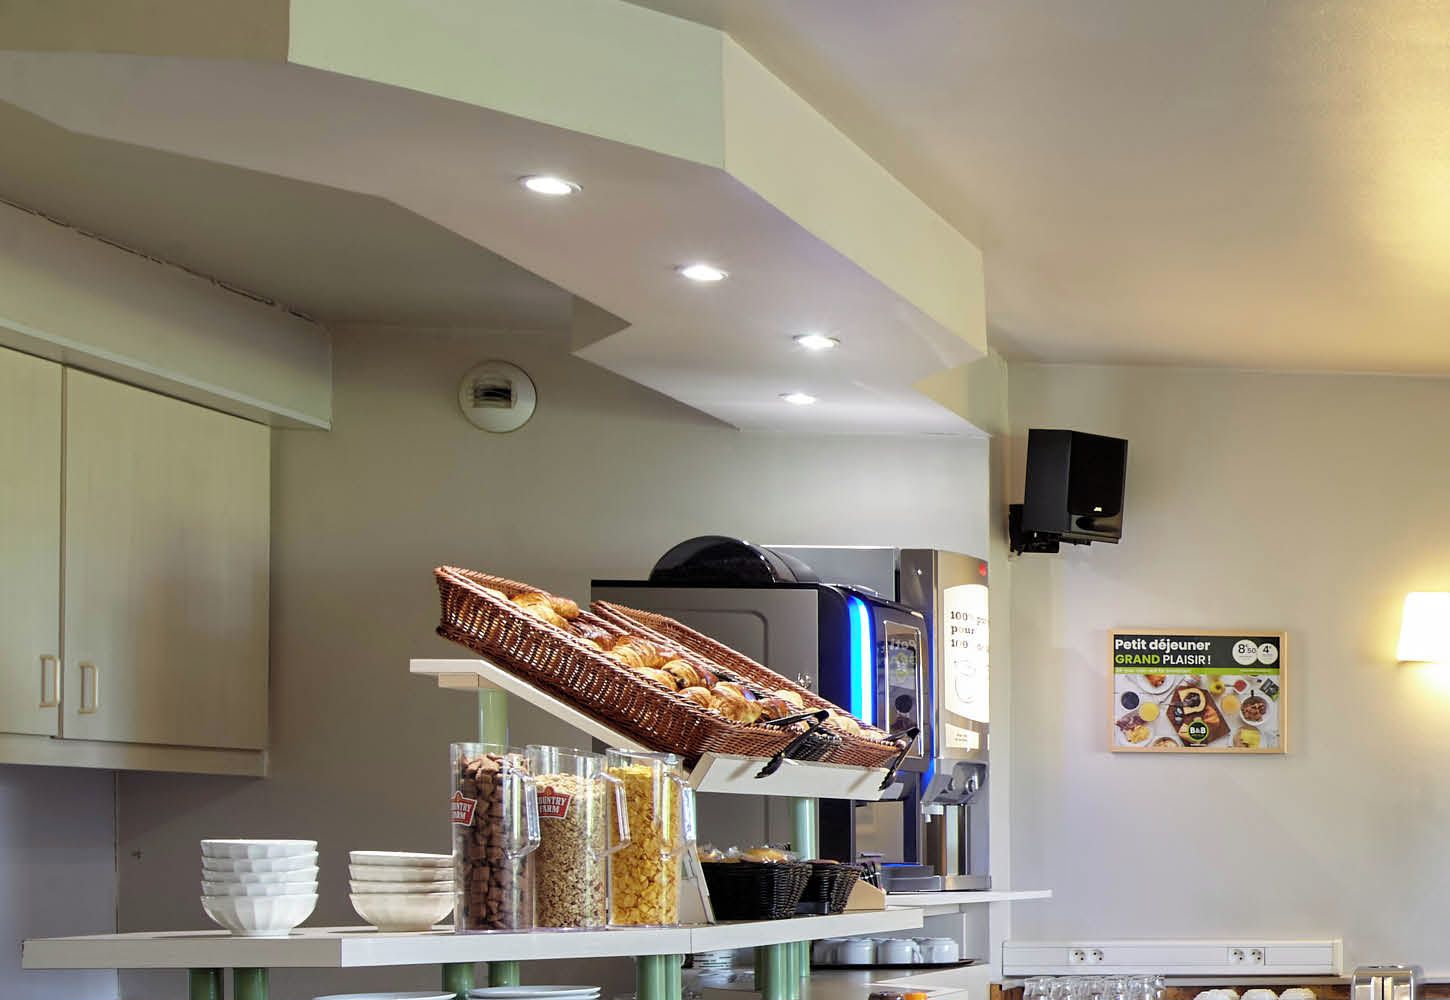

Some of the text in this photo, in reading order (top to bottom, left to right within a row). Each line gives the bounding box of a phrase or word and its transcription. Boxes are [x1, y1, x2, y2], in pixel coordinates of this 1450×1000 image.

[1115, 638, 1210, 653] Petit déjeuner
[1115, 654, 1160, 664] GRAND
[1163, 655, 1205, 665] PLAISIR
